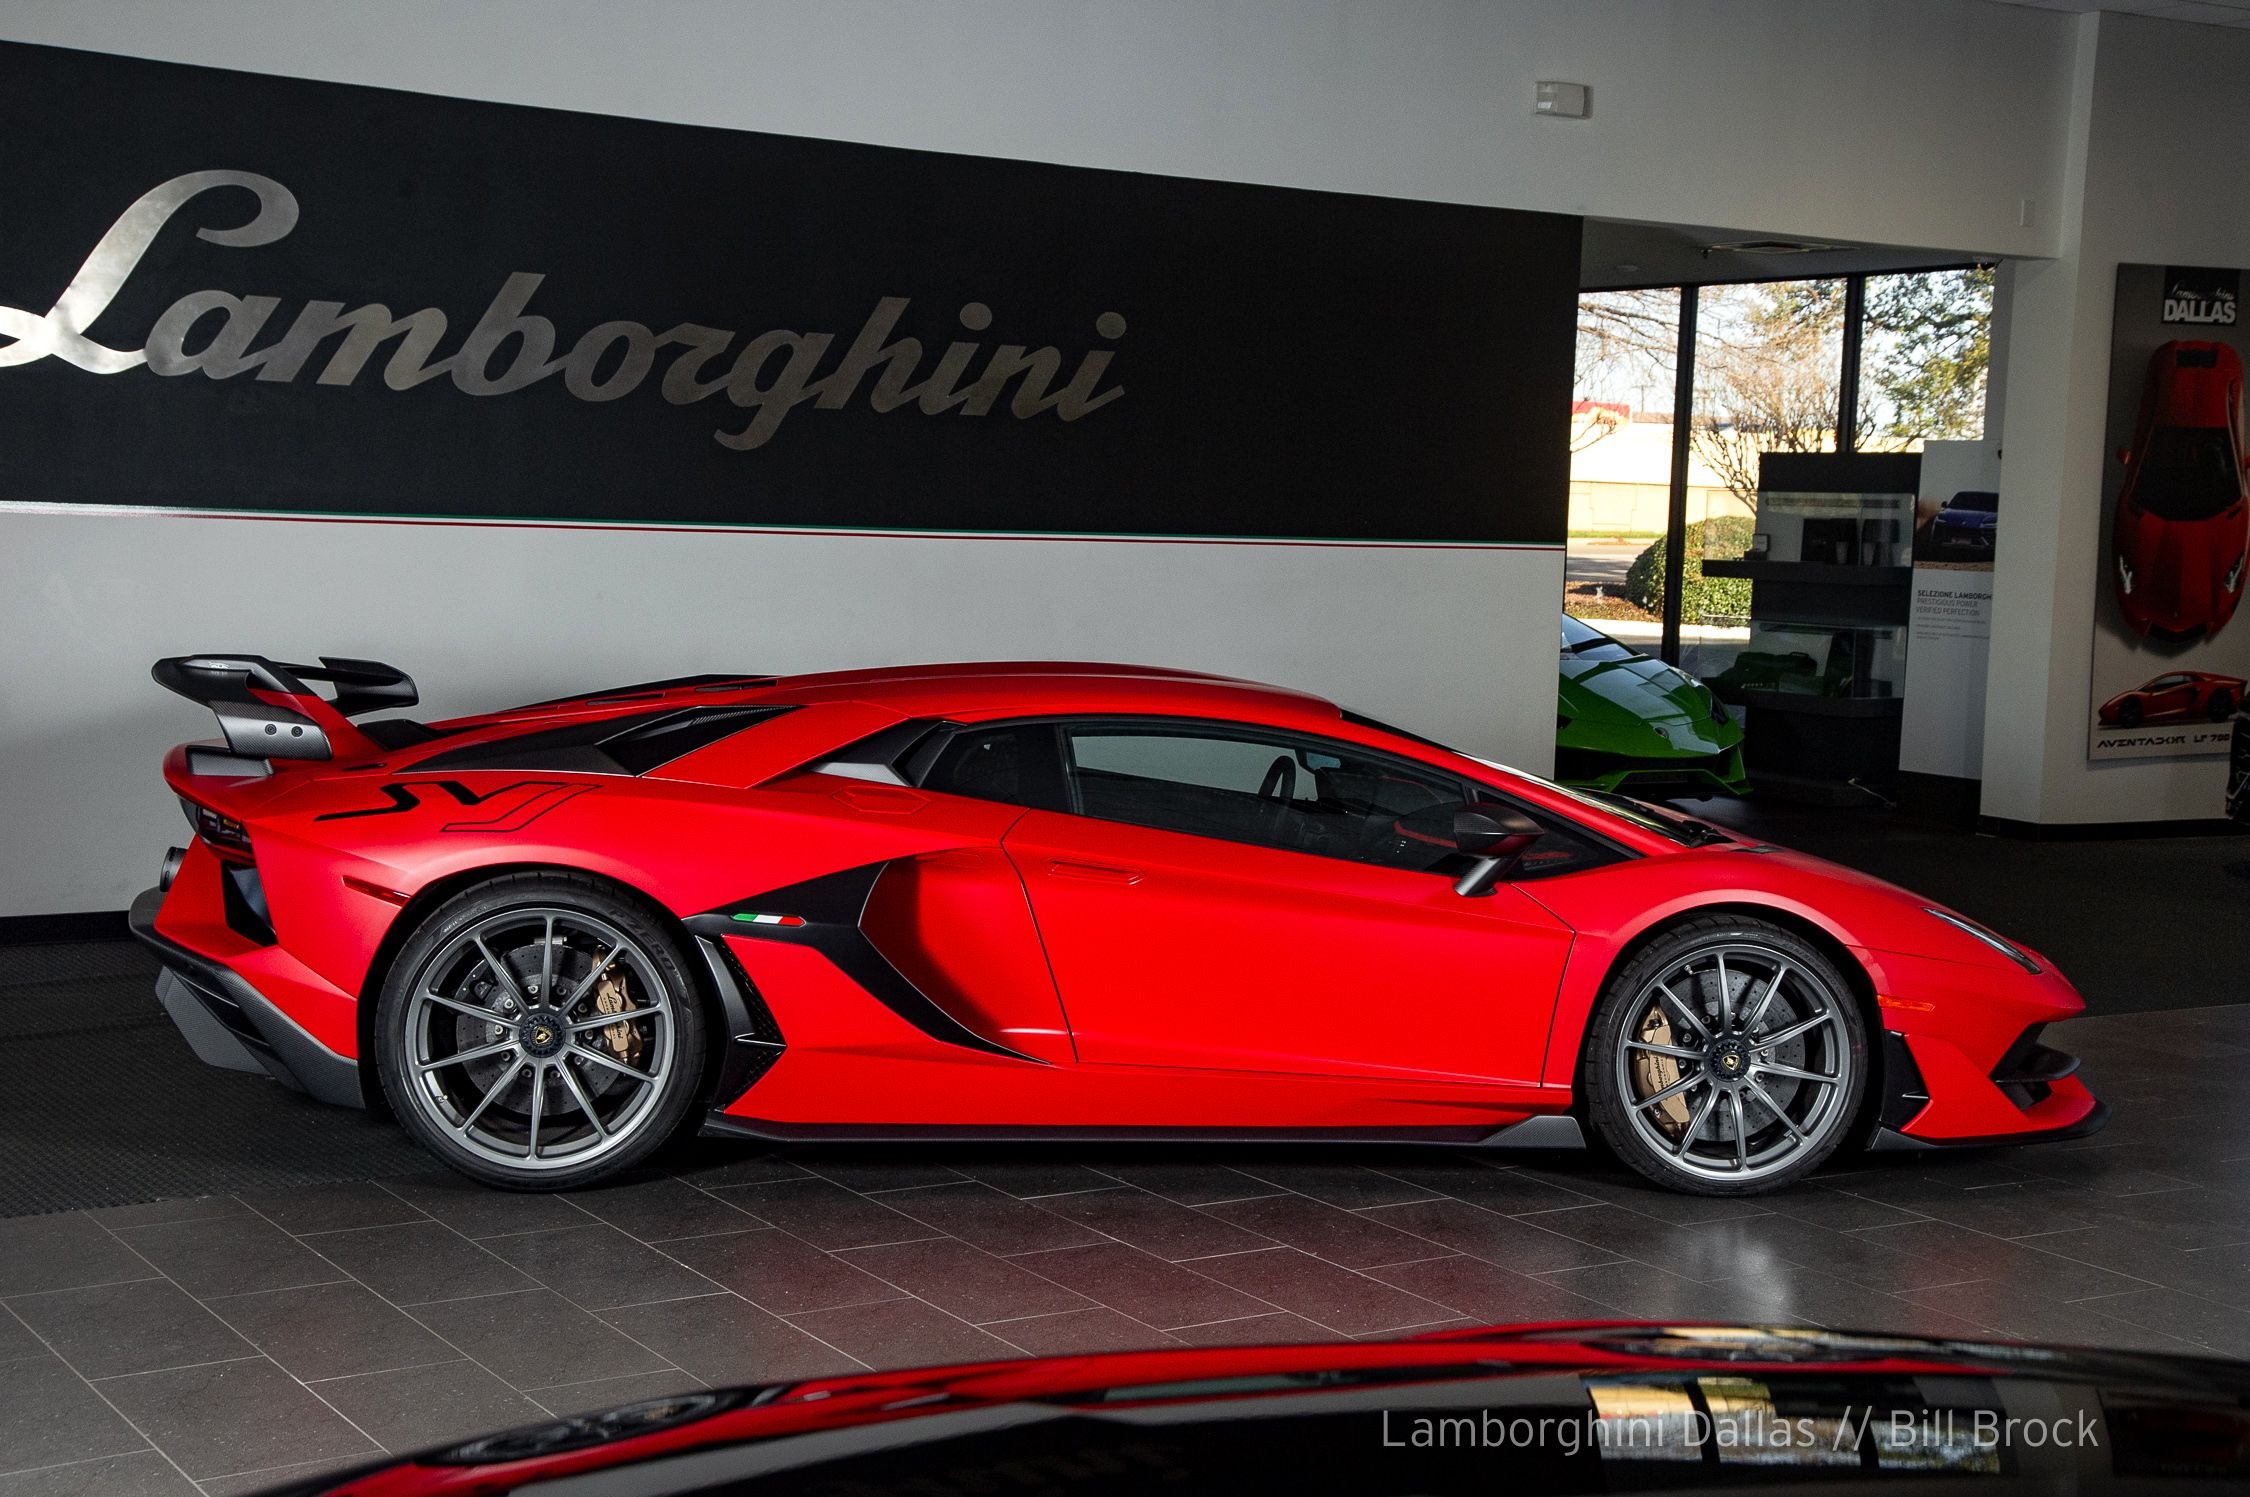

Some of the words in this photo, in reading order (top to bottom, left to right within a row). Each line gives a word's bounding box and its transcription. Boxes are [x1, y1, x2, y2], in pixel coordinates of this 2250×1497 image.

[0, 168, 1125, 452] Lamborghini
[2163, 299, 2236, 324] DALLAS
[1917, 590, 1953, 598] SELEZIONE
[1956, 599, 1979, 608] POWER
[1916, 606, 1942, 614] VERIFIED
[1943, 608, 1980, 616] PERFECTION
[2097, 735, 2186, 748] AVENTADOR
